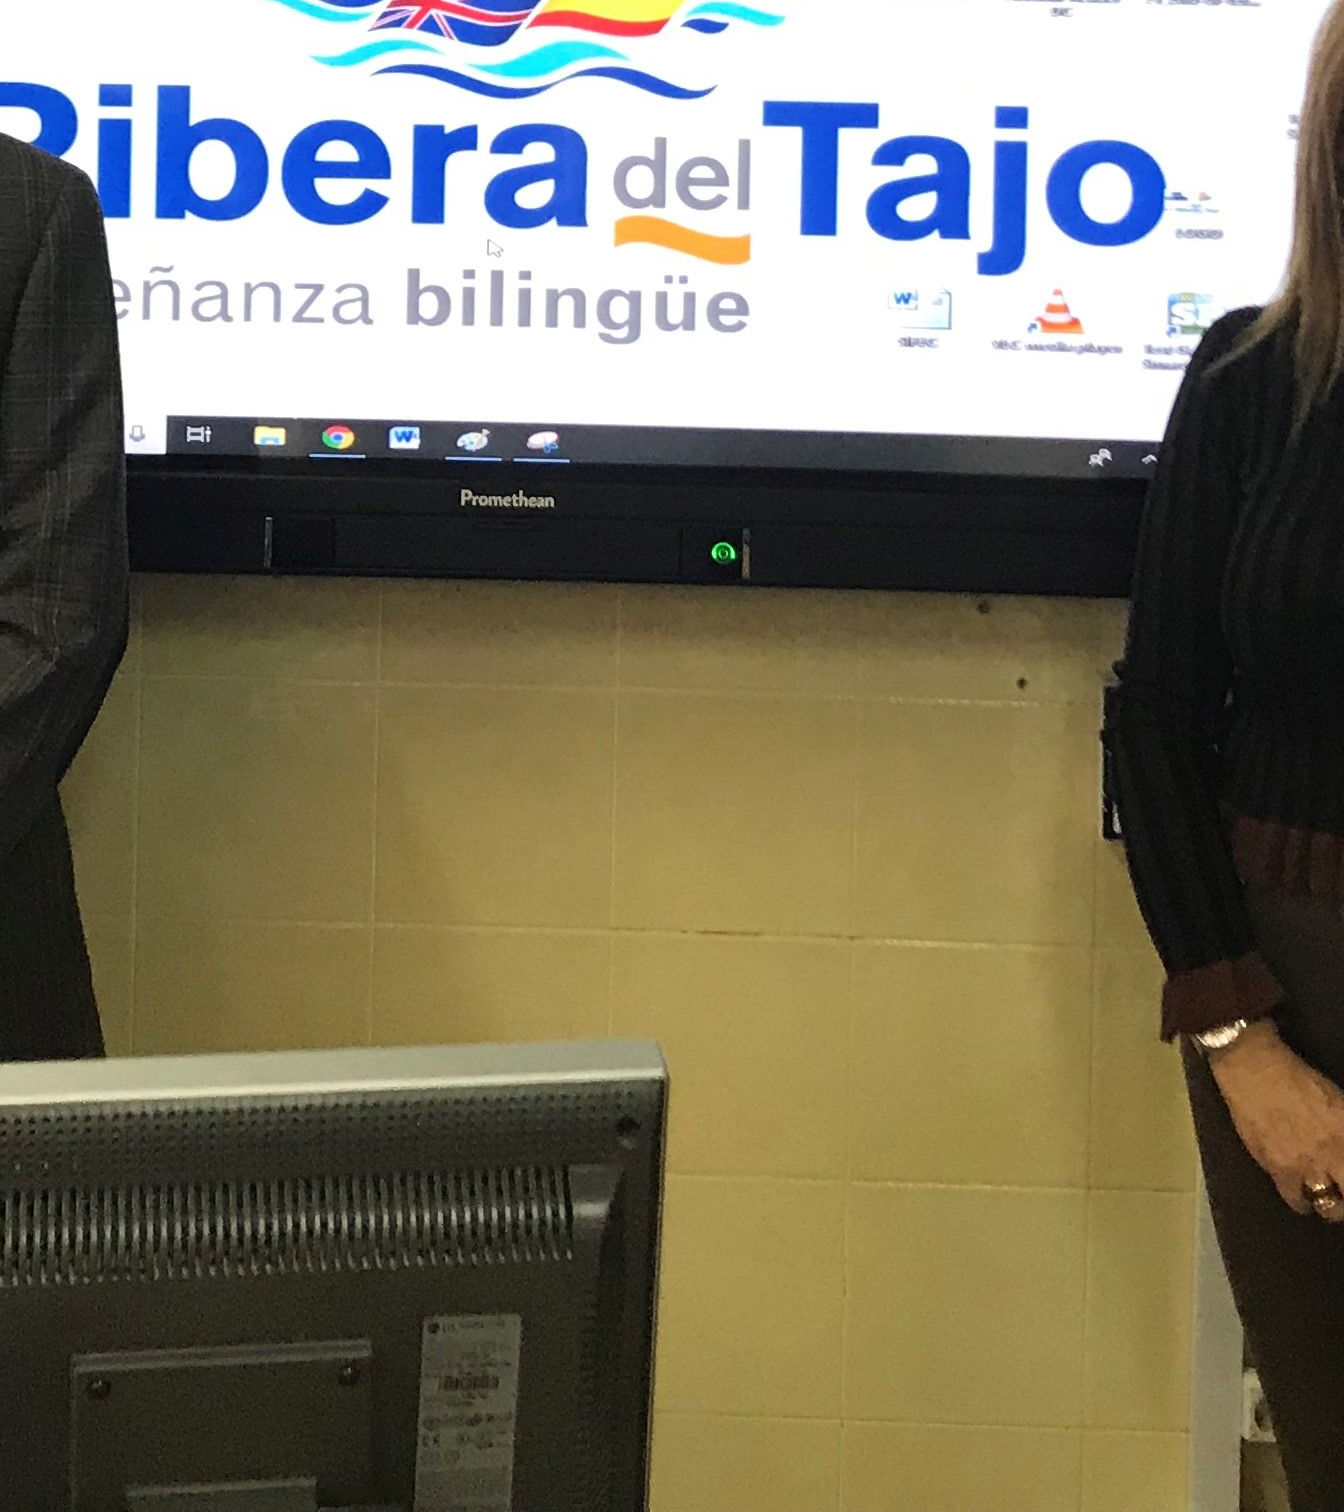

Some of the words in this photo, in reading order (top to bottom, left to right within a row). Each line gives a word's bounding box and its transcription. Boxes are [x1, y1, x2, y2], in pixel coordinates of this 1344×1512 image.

[613, 136, 752, 211] del
[762, 100, 1167, 276] Tajo
[406, 267, 751, 346] bilingüe
[460, 488, 555, 508] Promethean
